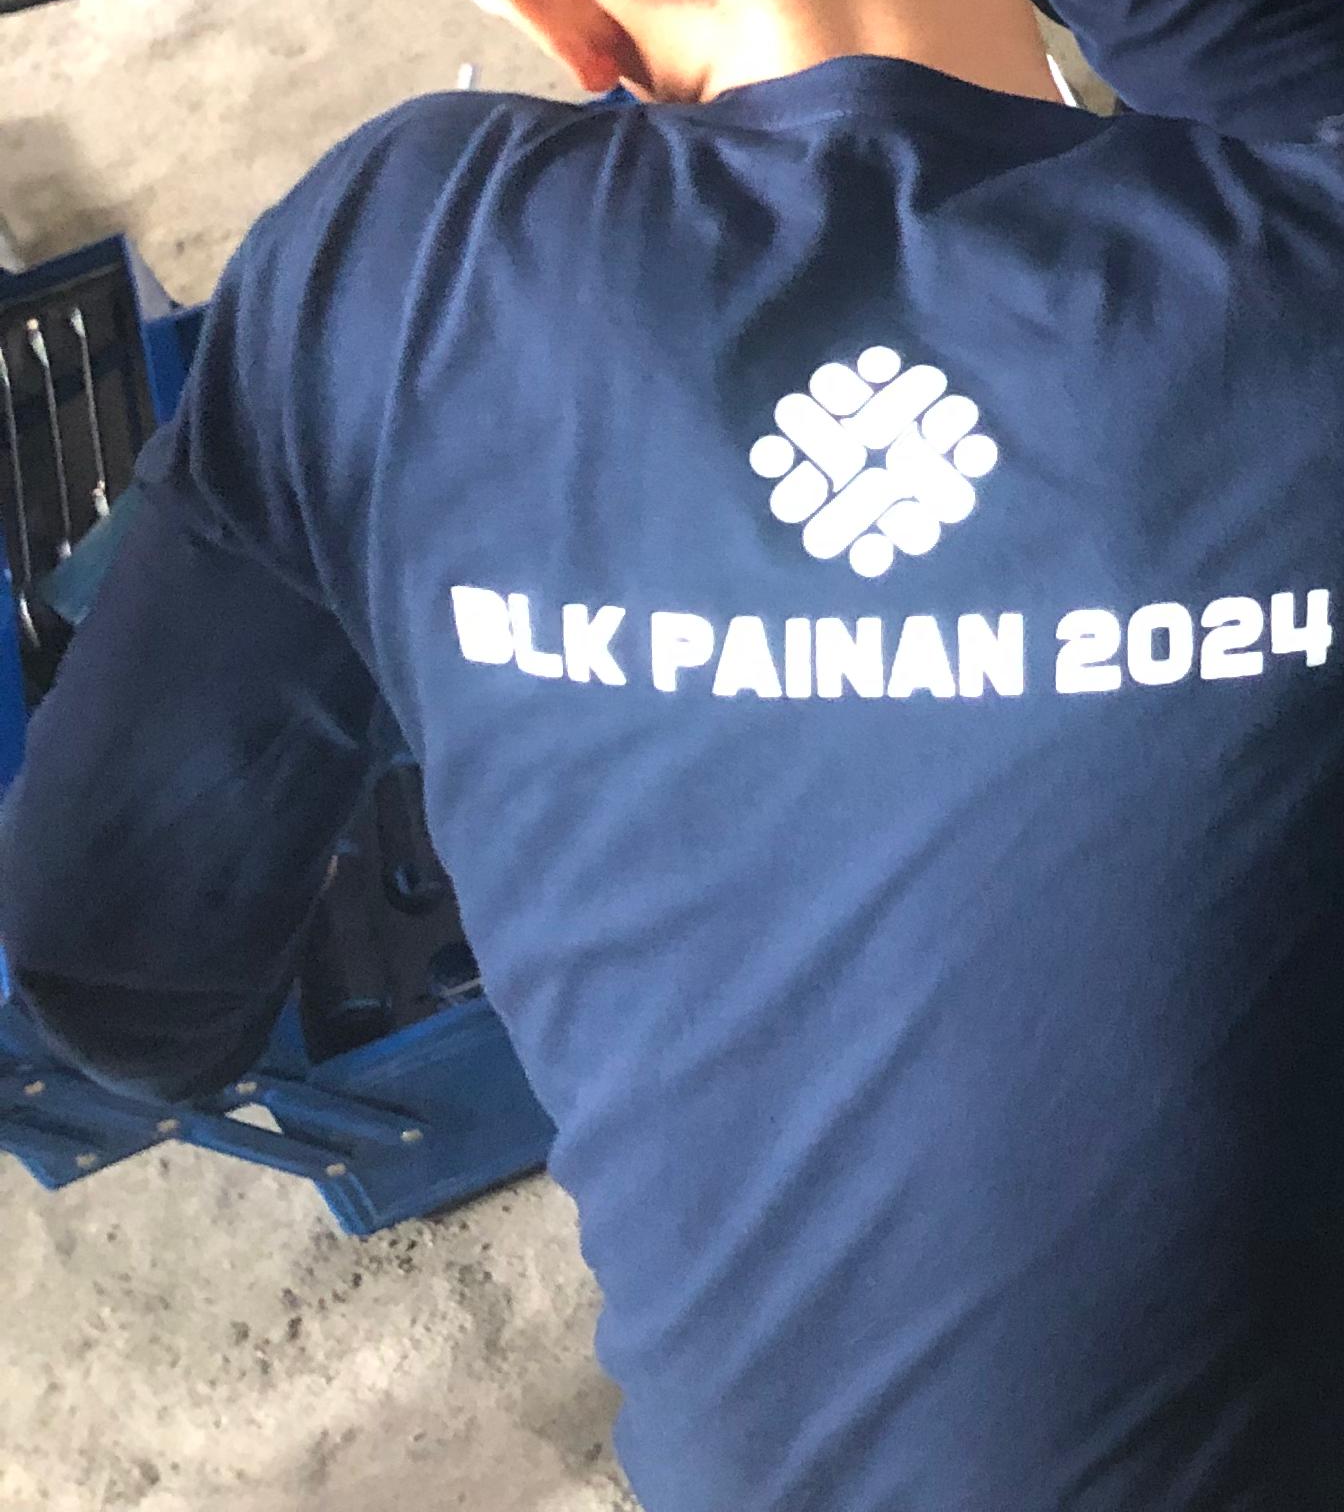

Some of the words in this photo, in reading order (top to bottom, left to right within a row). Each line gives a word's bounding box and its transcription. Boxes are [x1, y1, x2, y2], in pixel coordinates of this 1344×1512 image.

[451, 585, 627, 686] BLK
[651, 610, 1024, 698] PAINAN
[1055, 588, 1333, 694] 2024
